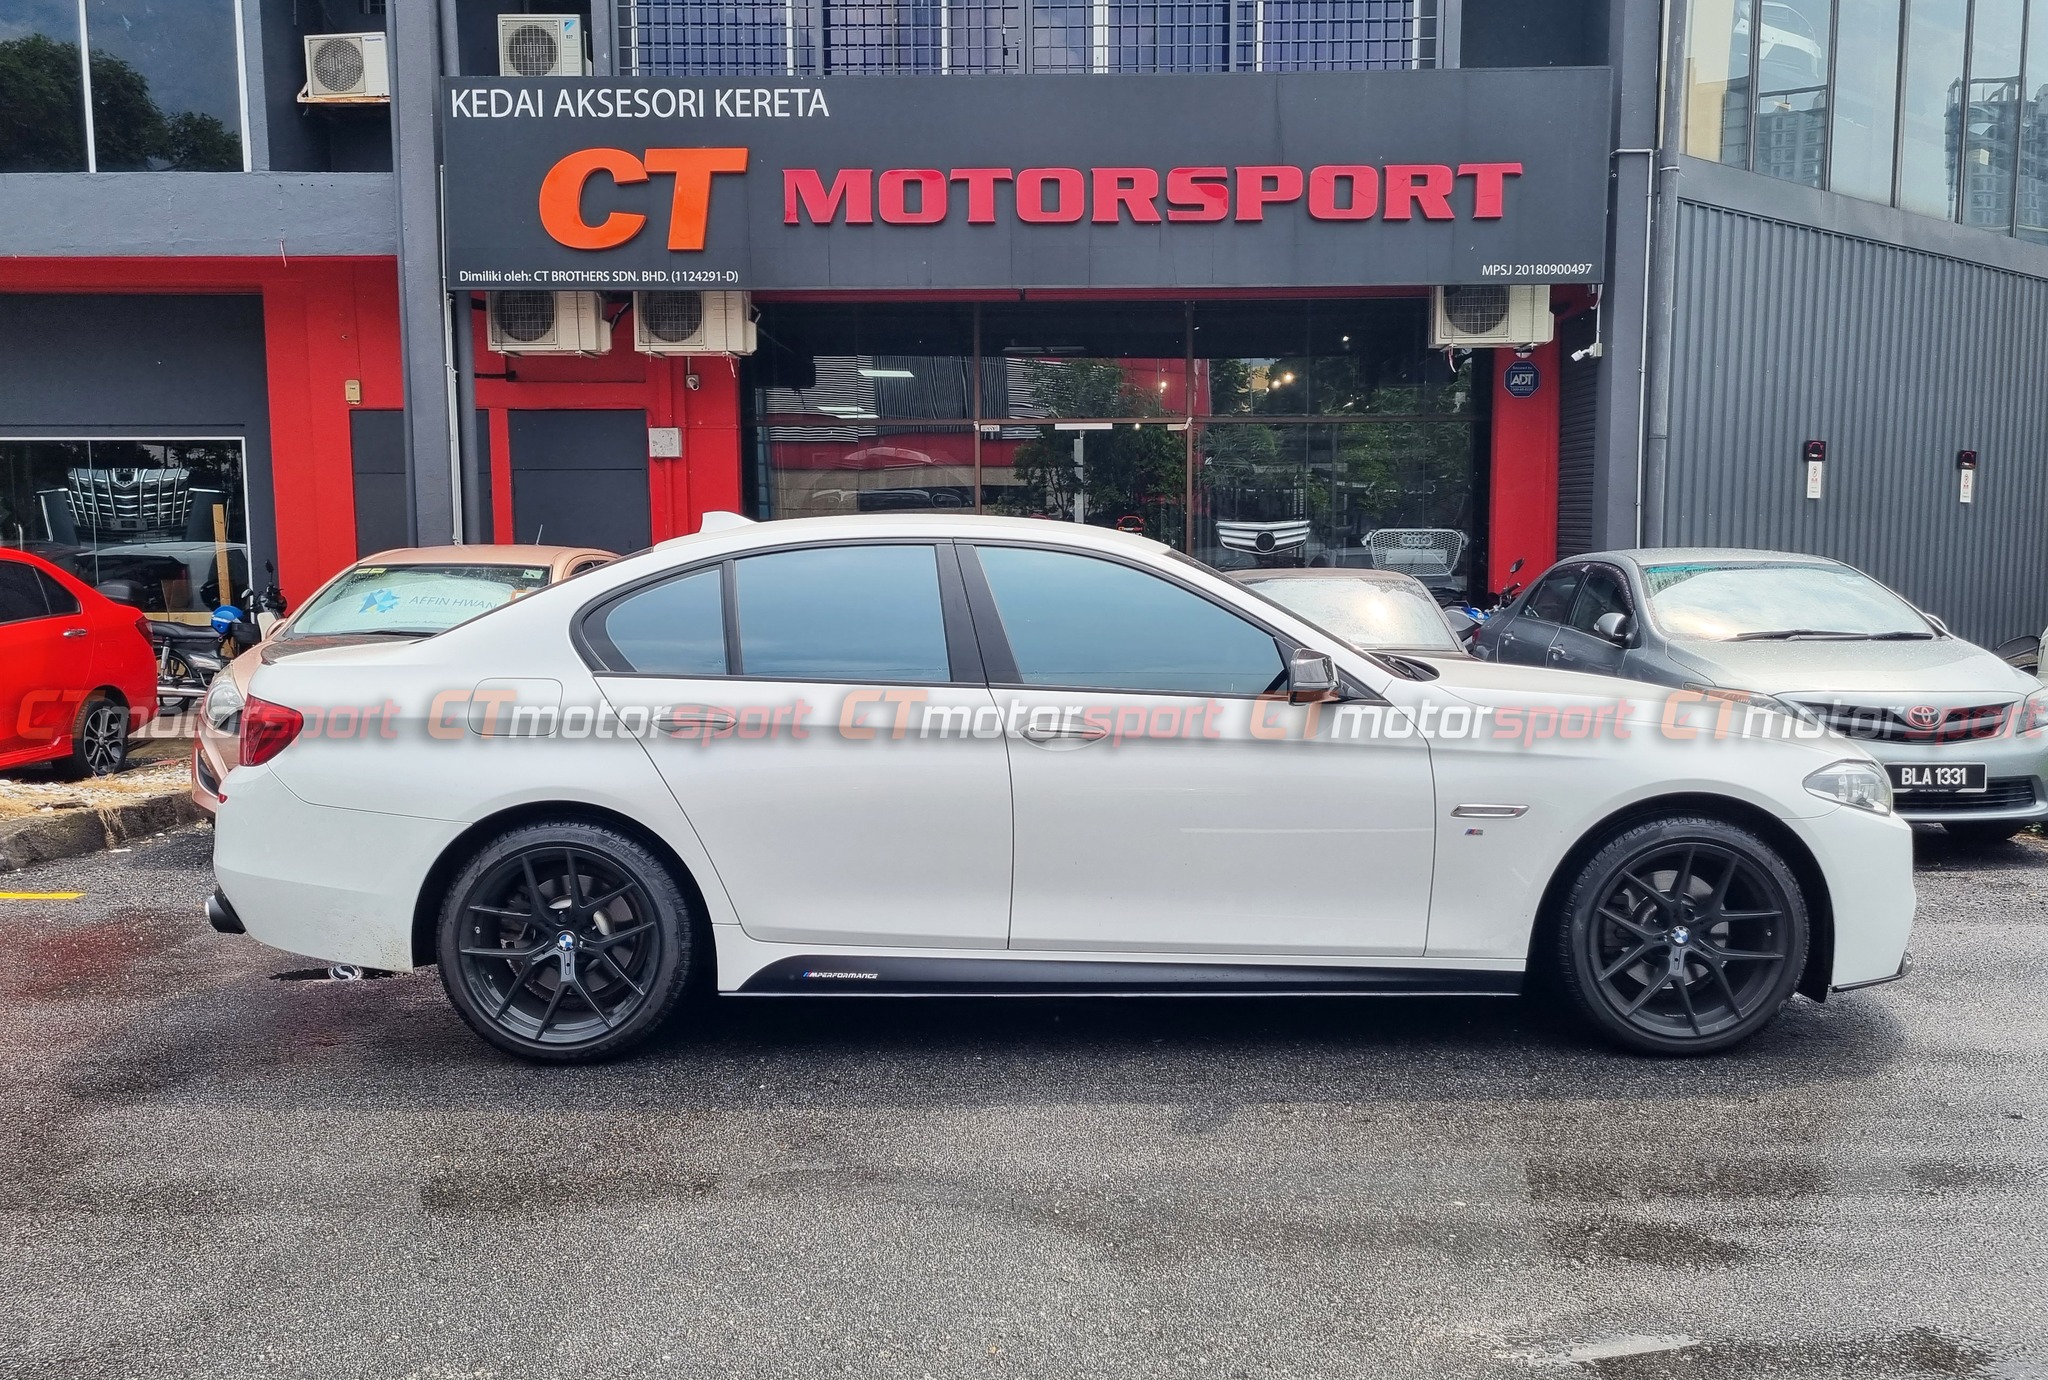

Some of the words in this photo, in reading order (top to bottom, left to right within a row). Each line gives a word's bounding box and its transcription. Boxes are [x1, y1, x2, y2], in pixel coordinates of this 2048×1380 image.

[452, 89, 543, 117] KEDAI
[554, 88, 704, 118] AKSESORI
[716, 88, 829, 117] KERETA
[539, 147, 748, 251] CT
[783, 163, 1523, 225] MOTORSPORT
[459, 270, 502, 282] Dimiliki
[503, 270, 532, 282] oleh:
[533, 270, 550, 282] CT
[551, 270, 610, 282] BROTHERS
[612, 270, 640, 282] SDN.
[641, 270, 669, 282] BHD.
[671, 270, 739, 283] (1124291-D)
[1482, 264, 1513, 276] MPSJ
[1514, 264, 1593, 275] 20180900497
[1510, 373, 1534, 386] ADT
[409, 596, 450, 606] AFFIN
[1901, 767, 1932, 785] BLA
[1935, 767, 1966, 785] 1331
